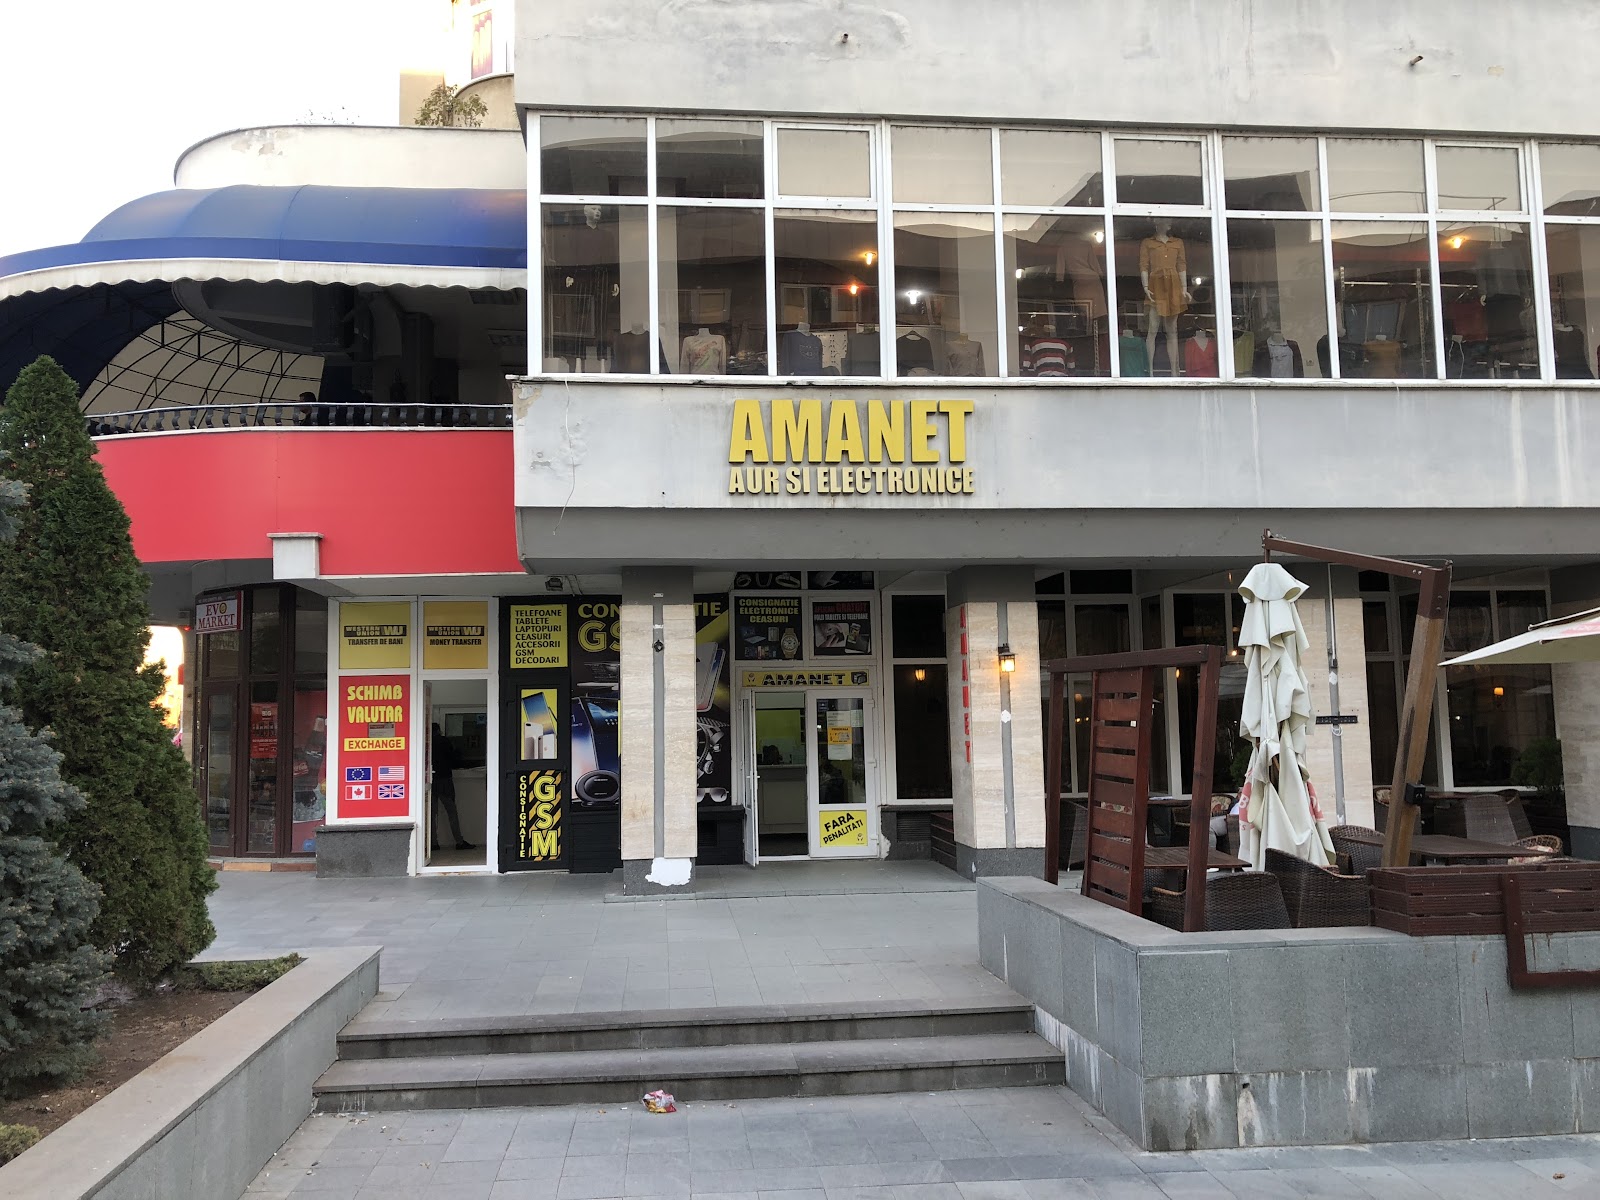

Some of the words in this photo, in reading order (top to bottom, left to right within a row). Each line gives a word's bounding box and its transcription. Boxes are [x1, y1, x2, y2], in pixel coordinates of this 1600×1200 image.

[728, 399, 974, 463] AMANET
[728, 466, 780, 494] AUR
[785, 466, 811, 494] SI
[816, 466, 975, 494] ELECTRONICE
[205, 602, 227, 616] EVO
[739, 598, 799, 607] CONSIGNATIE
[515, 609, 562, 617] TELEFOANE
[739, 606, 799, 615] ELECTRONICE
[198, 613, 235, 629] MARKET
[515, 617, 549, 625] TABLETE
[749, 615, 789, 623] CEASURI
[515, 625, 562, 633] LAPTOPURI
[515, 641, 560, 649] ACCESORII
[515, 656, 560, 664] DECODARI
[763, 673, 845, 686] AMANET
[347, 685, 403, 701] SCHIMB
[347, 705, 403, 724] VALUTAR
[348, 739, 402, 749] EXCHANGE
[519, 775, 527, 858] CONSIGNATIE
[531, 775, 558, 857] GSM
[824, 812, 855, 832] FARA
[822, 818, 864, 844] PENALITATI
